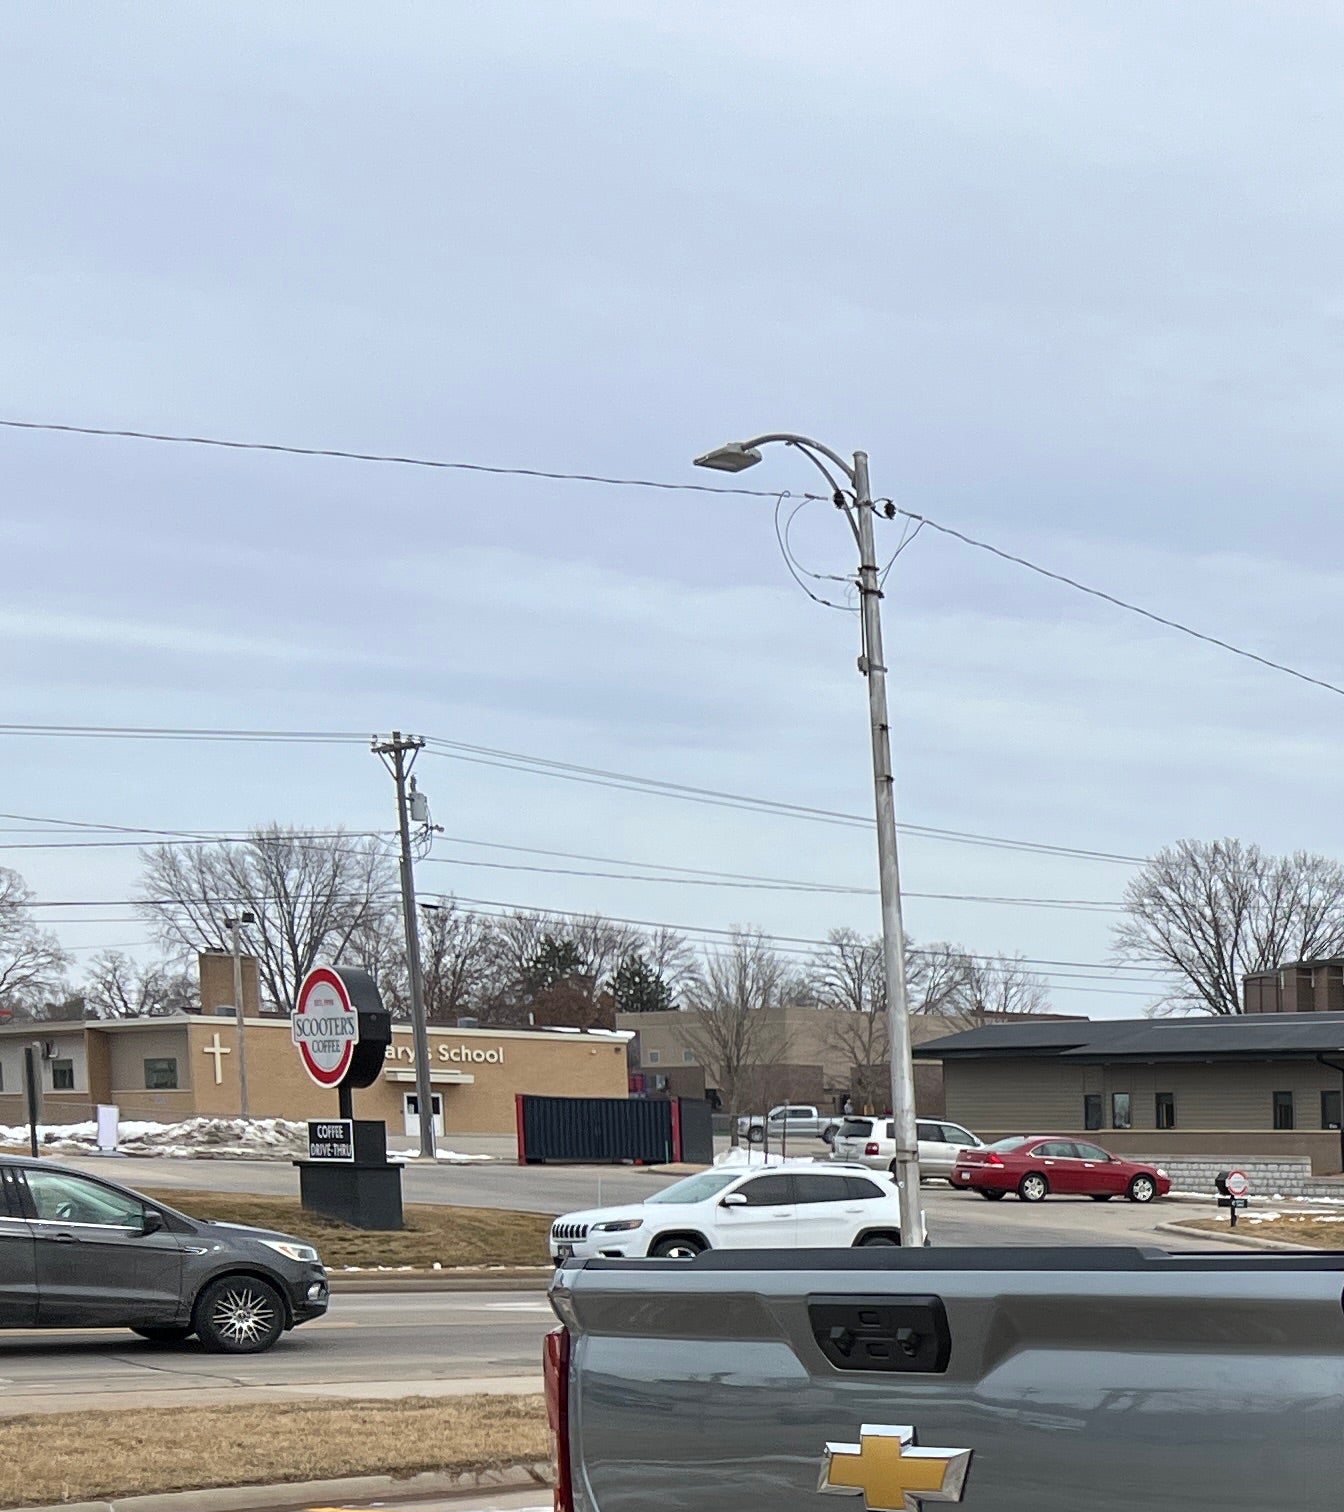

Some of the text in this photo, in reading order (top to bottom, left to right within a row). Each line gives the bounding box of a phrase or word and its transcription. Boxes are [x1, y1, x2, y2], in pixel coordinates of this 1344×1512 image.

[296, 1016, 355, 1037] SCOOTER'S
[312, 1040, 341, 1053] COFFEE
[438, 1044, 504, 1064] School
[317, 1124, 344, 1139] COFFEE
[310, 1143, 352, 1157] DRIVE-THRU
